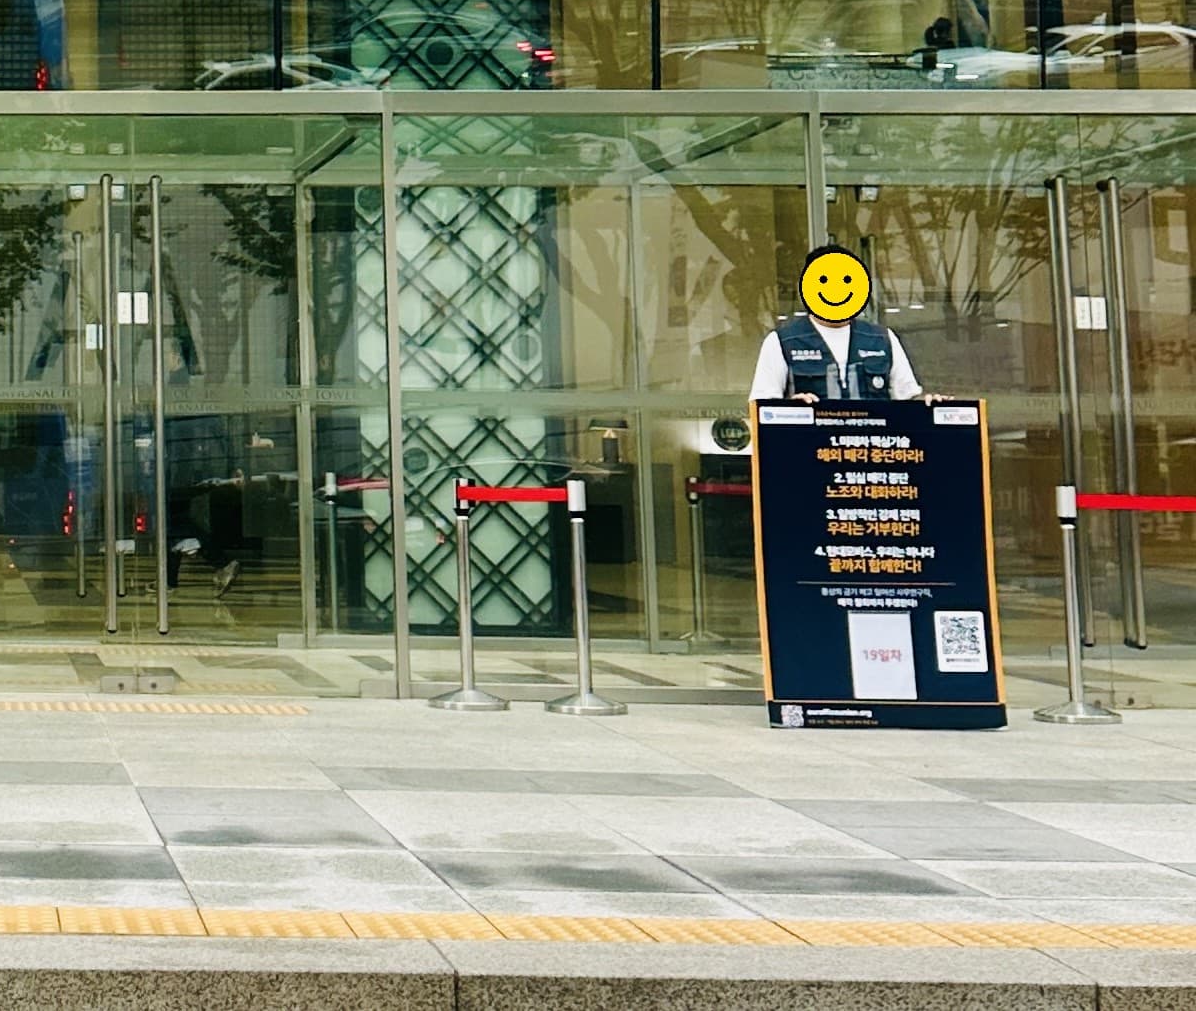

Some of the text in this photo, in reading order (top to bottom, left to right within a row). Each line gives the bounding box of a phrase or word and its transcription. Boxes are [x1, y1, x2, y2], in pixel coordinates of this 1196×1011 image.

[816, 448, 842, 462] 해외
[870, 448, 924, 463] 중단하라!
[826, 485, 918, 499] 노조와 대화하라!
[827, 521, 920, 536] 우리는 거부한다!
[829, 558, 866, 573] 끝까지
[862, 648, 903, 663] 19일차
